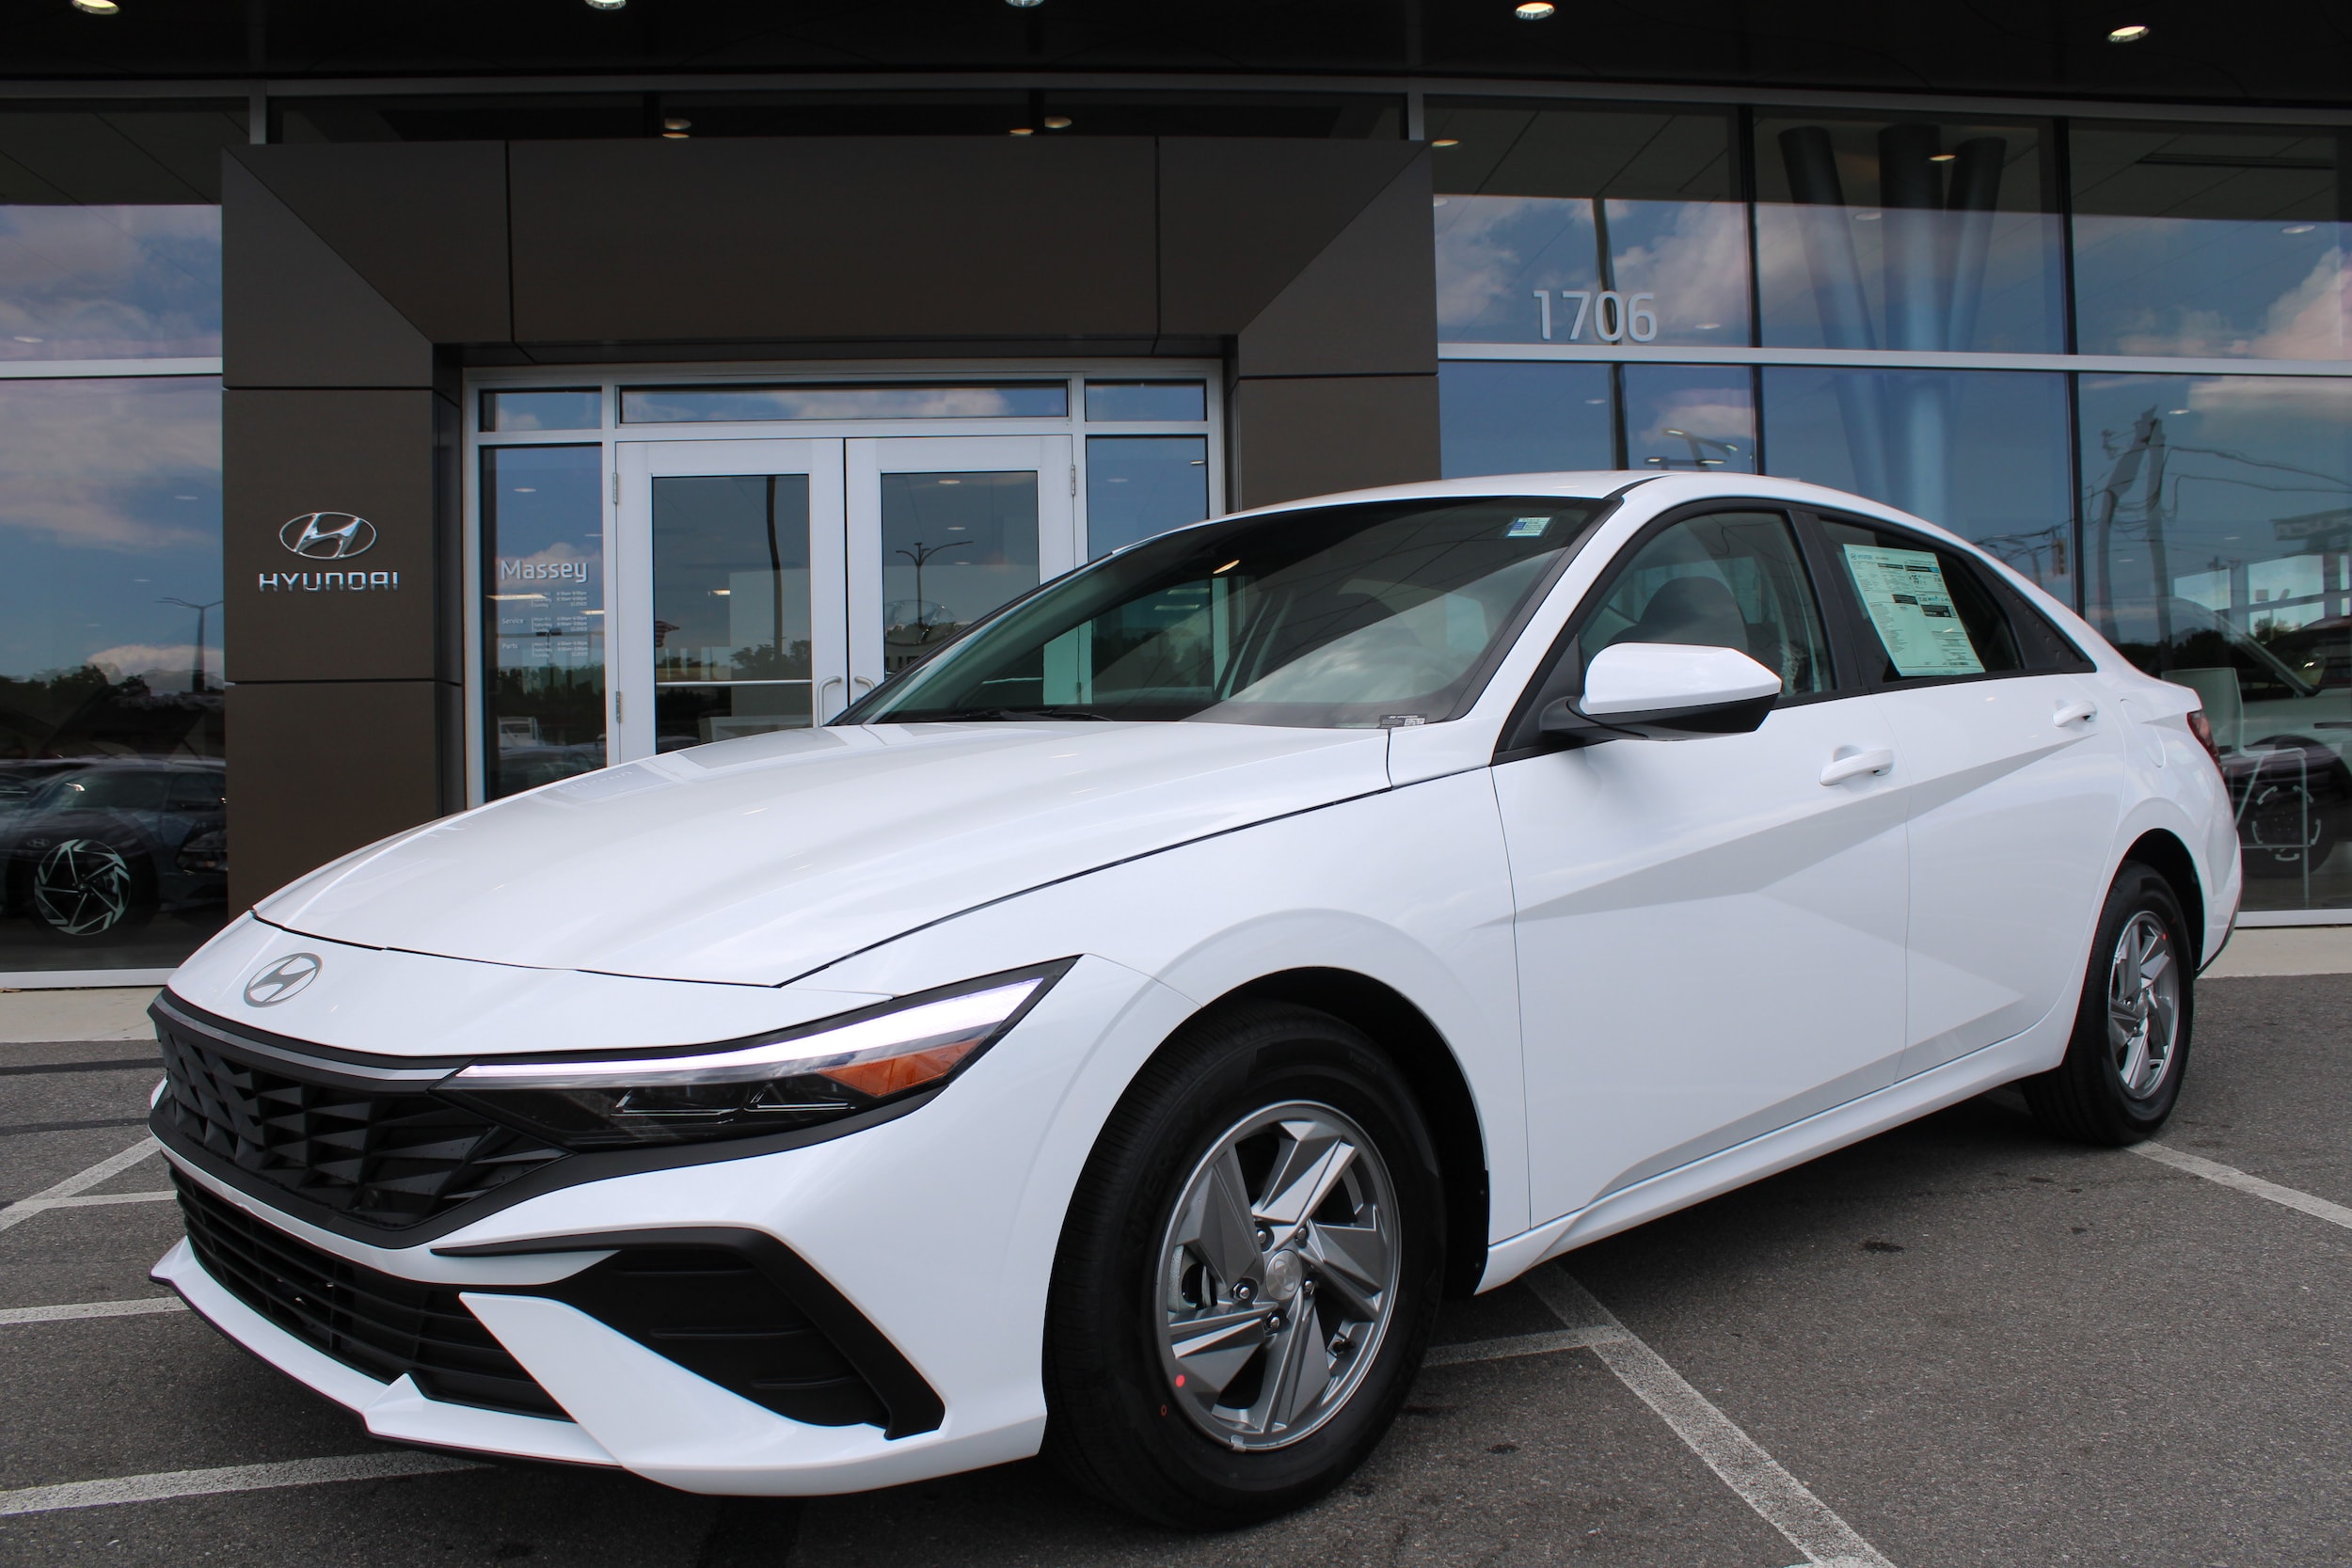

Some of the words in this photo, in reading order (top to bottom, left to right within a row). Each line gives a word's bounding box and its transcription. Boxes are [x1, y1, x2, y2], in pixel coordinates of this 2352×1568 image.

[1534, 290, 1658, 342] 1706
[259, 571, 399, 592] HYUNDAI
[501, 560, 588, 583] Massey
